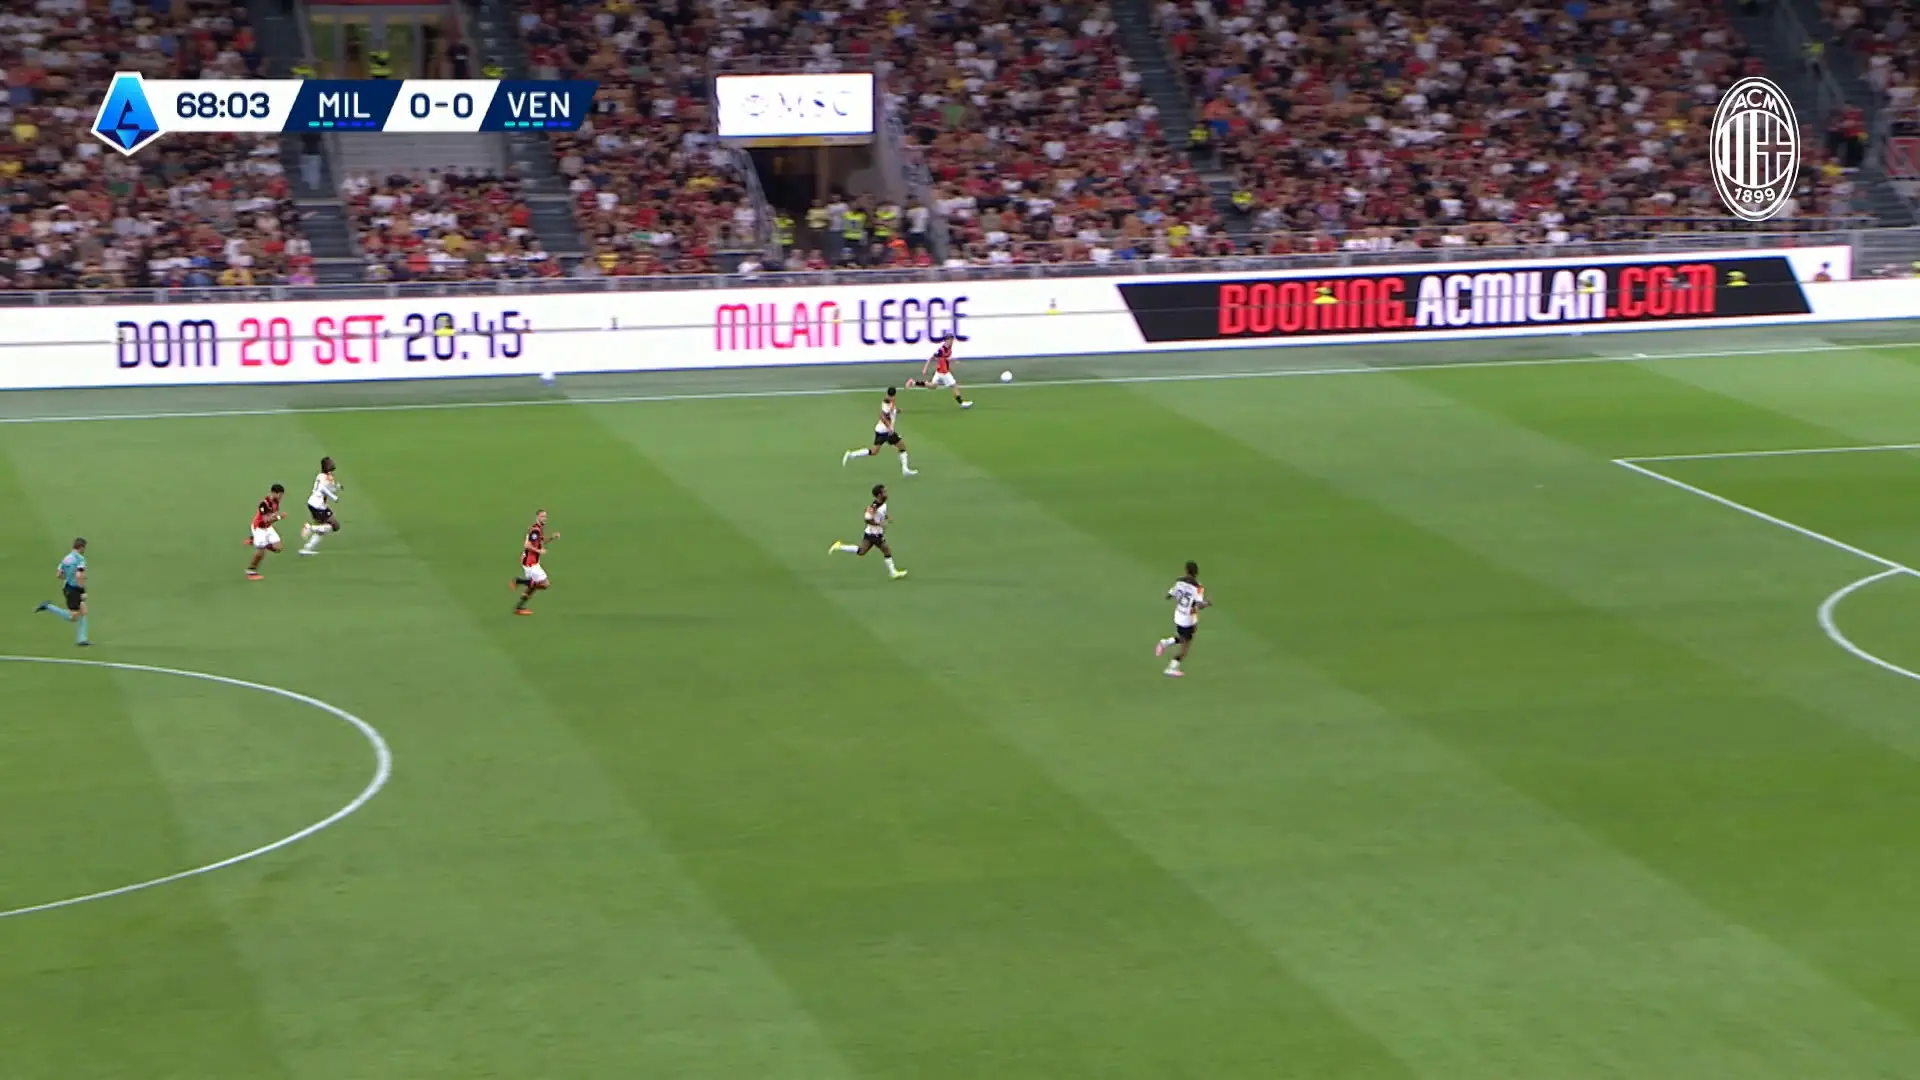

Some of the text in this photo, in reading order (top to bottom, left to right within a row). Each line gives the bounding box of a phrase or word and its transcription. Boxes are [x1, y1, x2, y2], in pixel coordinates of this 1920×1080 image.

[116, 319, 218, 368] DOM
[240, 317, 291, 366] 20
[313, 314, 385, 365] SET
[715, 296, 969, 350] MILAN LECCE
